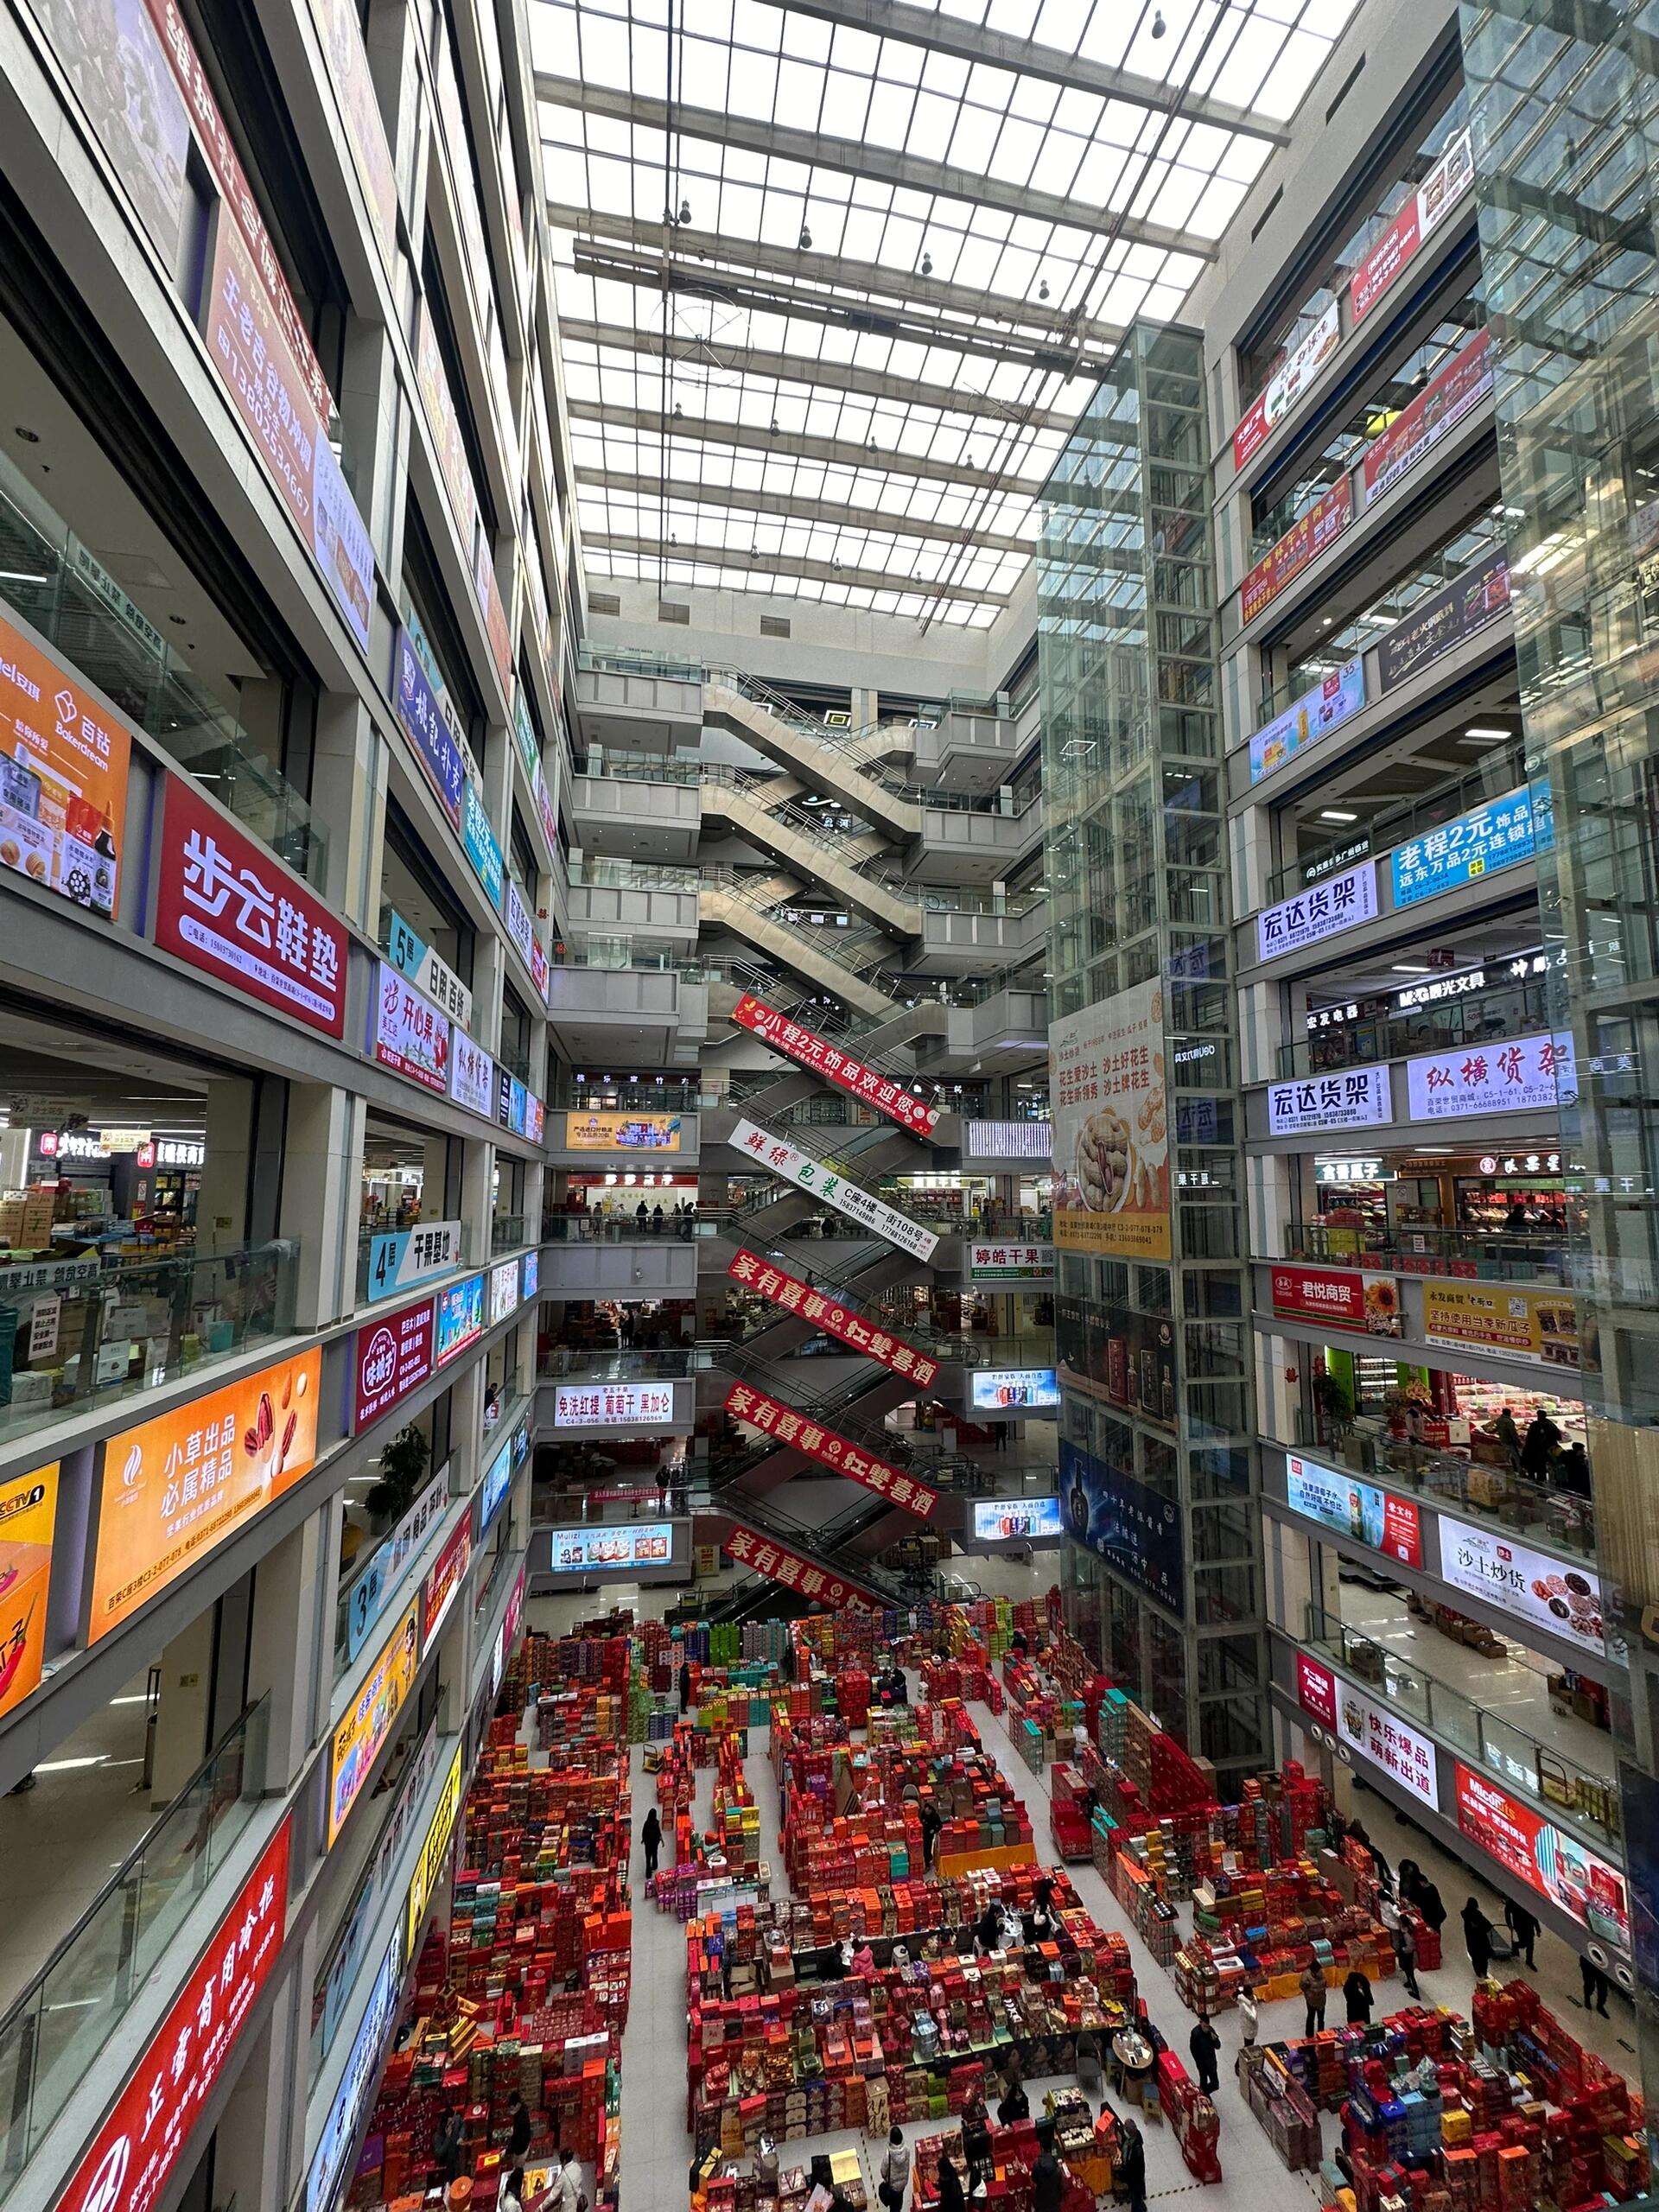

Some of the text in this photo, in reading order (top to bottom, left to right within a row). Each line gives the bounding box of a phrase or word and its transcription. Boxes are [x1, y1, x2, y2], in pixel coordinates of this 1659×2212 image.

[231, 346, 308, 527] 13802534667
[54, 718, 108, 773] Bakerdream
[80, 712, 111, 758] 百钻
[1397, 805, 1492, 874] 老程2元
[180, 817, 339, 994] 步云鞋垫
[1263, 875, 1356, 940] 宏达货架
[397, 926, 464, 1020] 5层 日用百货
[1400, 972, 1486, 1007] M&G晨光文具
[402, 990, 433, 1046] 开心果
[760, 1011, 916, 1116] 小程2元饰品欢迎您
[1103, 1044, 1148, 1075] 沙土好花生
[1426, 1036, 1571, 1100] 纵横货架
[1274, 1072, 1369, 1116] 宏达货架
[842, 1186, 925, 1243] C座4楼一街108号
[880, 1224, 918, 1250] 17788126168
[375, 1227, 450, 1288] 4层 干果基地
[733, 1254, 827, 1319] 家有喜事
[976, 1248, 1039, 1265] 婷皓干果
[1302, 1281, 1351, 1303] 君悦商贸
[1430, 1310, 1531, 1334] 坚持使用当季新瓜子
[559, 1392, 670, 1416] 免洗红提 葡萄干 黑加仑
[728, 1387, 825, 1452] 家有喜事
[162, 1411, 236, 1483] 小草出品
[160, 1445, 233, 1522] 必属精品
[556, 1531, 580, 1540] Mulizi
[728, 1530, 826, 1596] 家有喜事
[1457, 1546, 1525, 1593] 沙土炒货
[356, 1572, 378, 1634] 3层
[1368, 1709, 1428, 1771] 快乐爆品
[1370, 1733, 1430, 1798] 萌新出道
